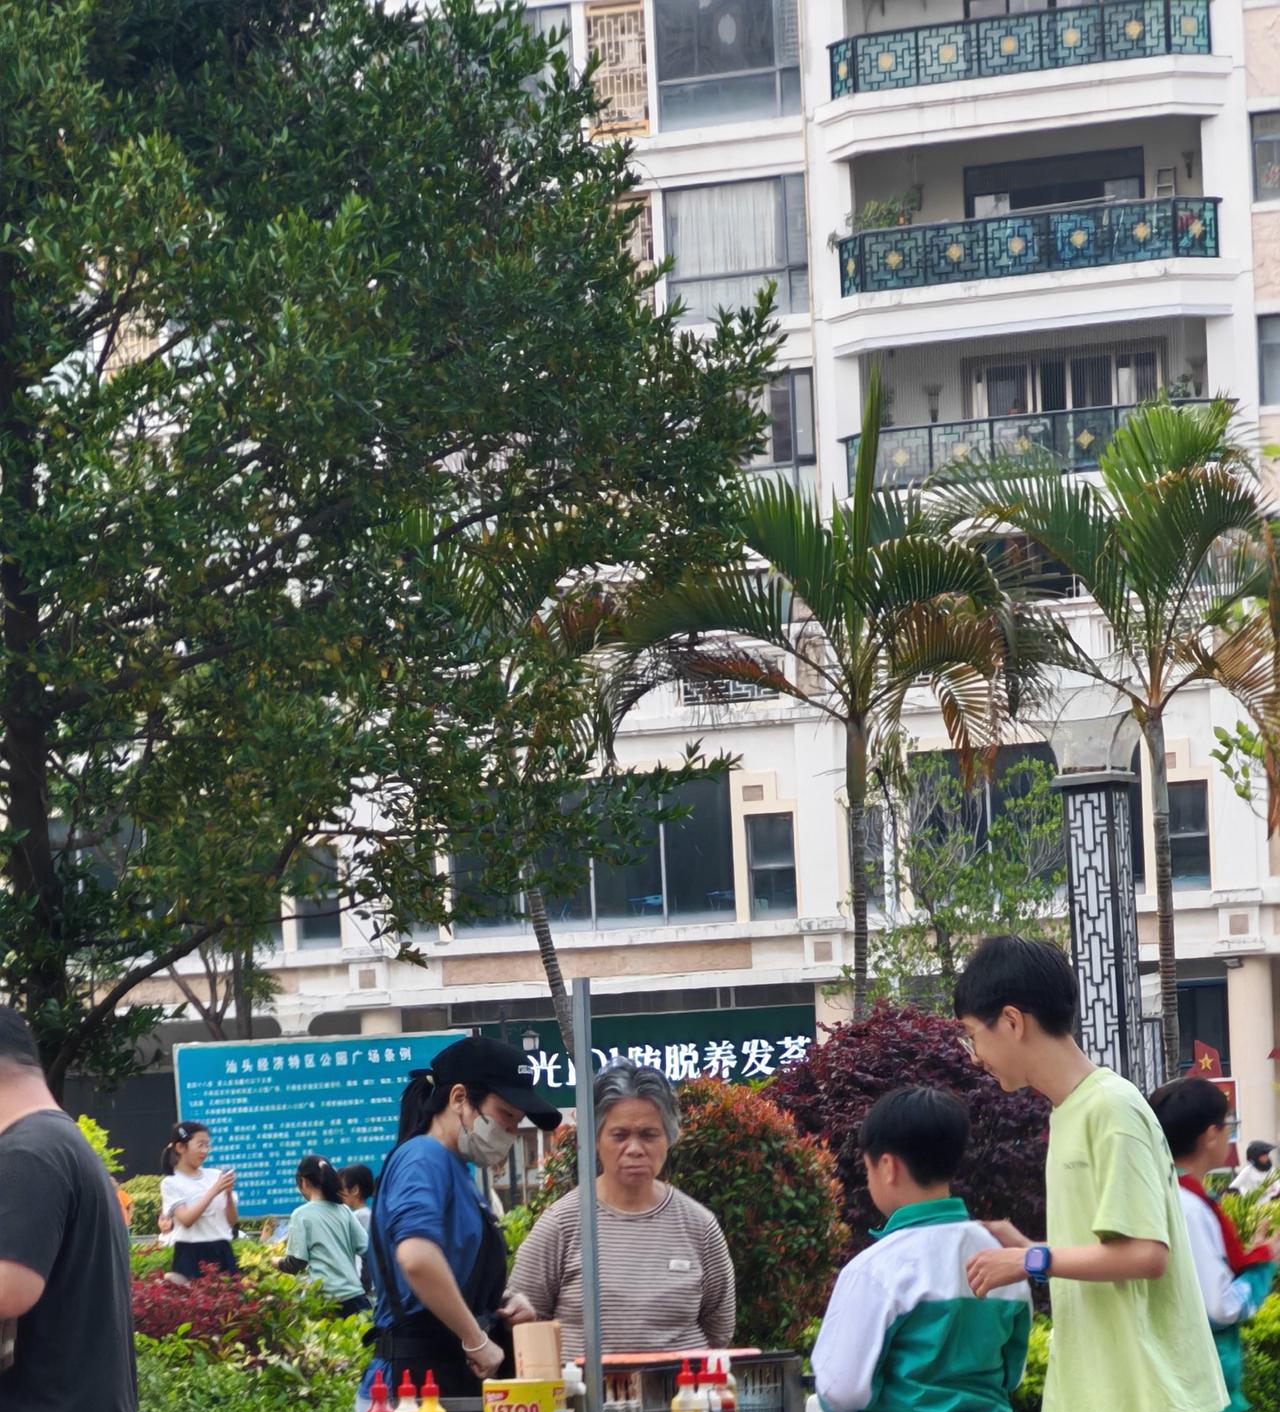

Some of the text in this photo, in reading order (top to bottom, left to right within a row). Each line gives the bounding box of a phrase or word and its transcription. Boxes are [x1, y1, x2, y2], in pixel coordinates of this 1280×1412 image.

[225, 1046, 412, 1074] 汕头经济特区公园广场条例
